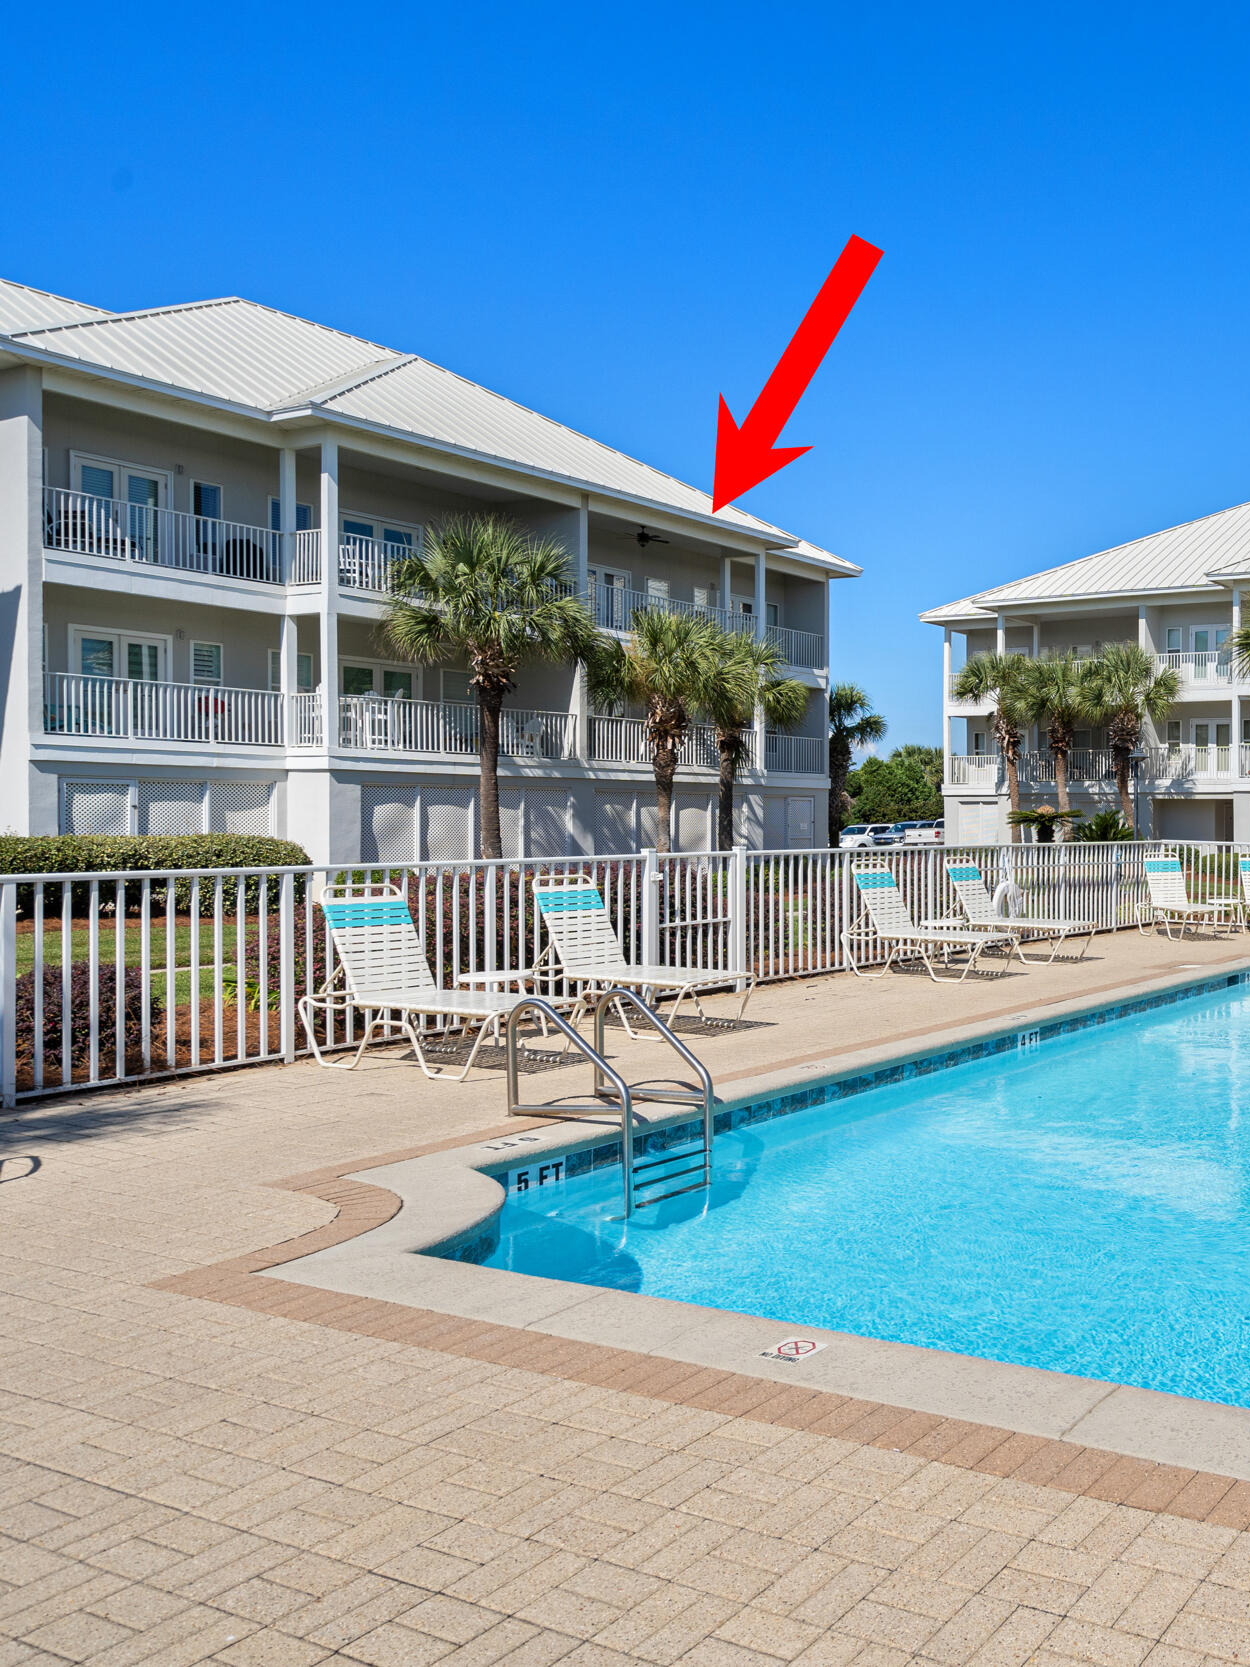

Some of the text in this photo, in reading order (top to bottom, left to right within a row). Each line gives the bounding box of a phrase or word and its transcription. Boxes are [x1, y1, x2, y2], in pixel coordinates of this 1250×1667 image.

[1021, 1031, 1038, 1045] 4 FT
[517, 1162, 563, 1192] 5 FT
[772, 1354, 799, 1362] DIVING
